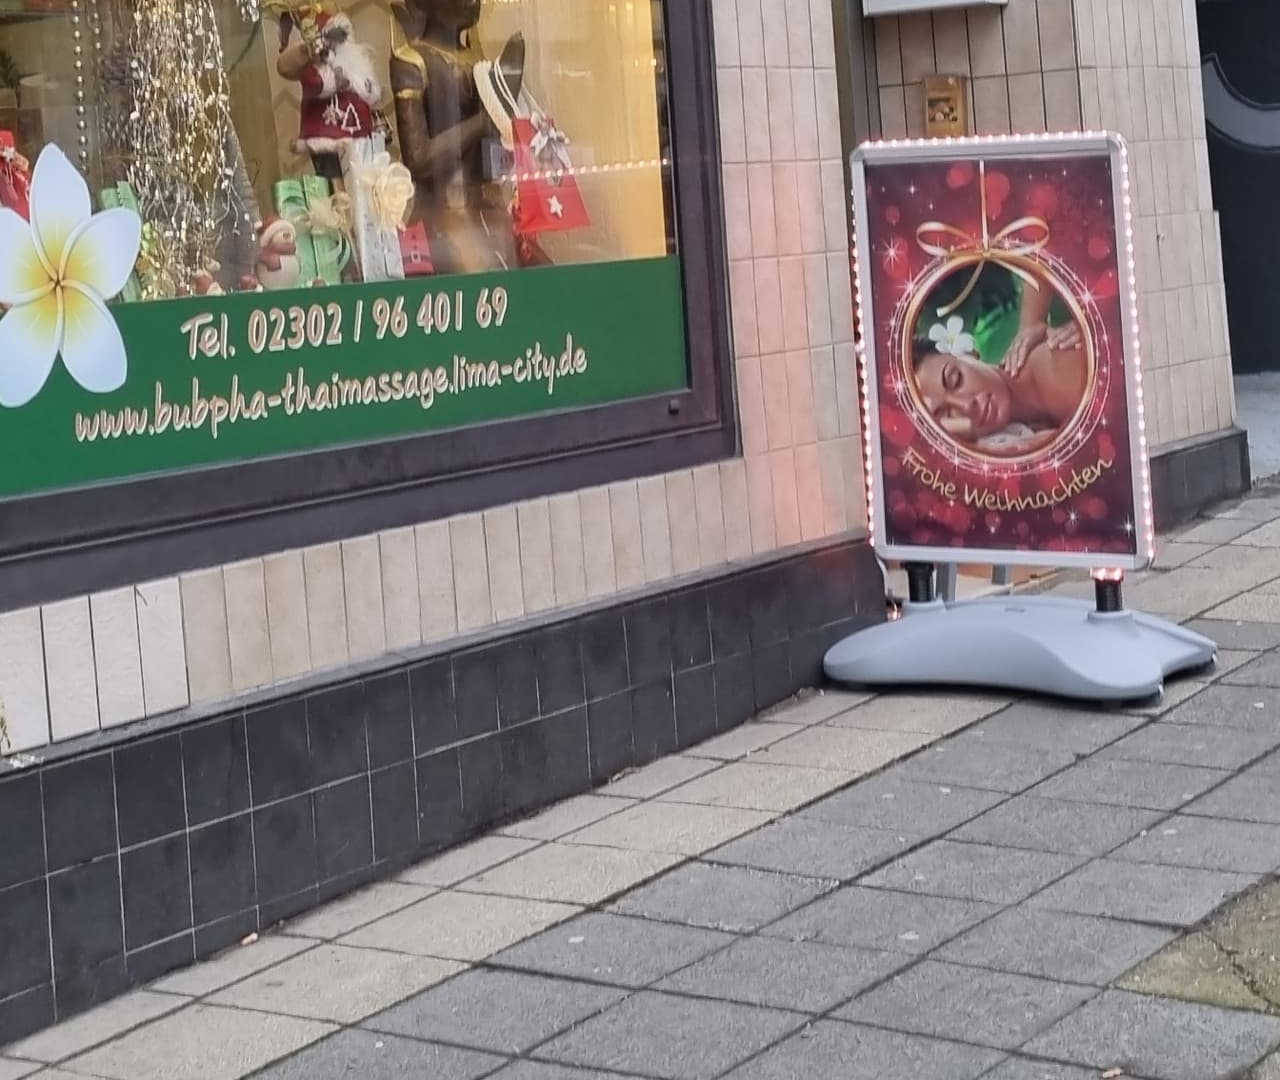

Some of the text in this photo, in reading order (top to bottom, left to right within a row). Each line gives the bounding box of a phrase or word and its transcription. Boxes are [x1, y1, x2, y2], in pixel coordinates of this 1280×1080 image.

[180, 286, 508, 360] Tel. 02302 / 96 401 69
[74, 331, 588, 443] www.bubpha-thaimassage.lima-city.de
[900, 446, 1113, 512] Frohe Weihnachten
